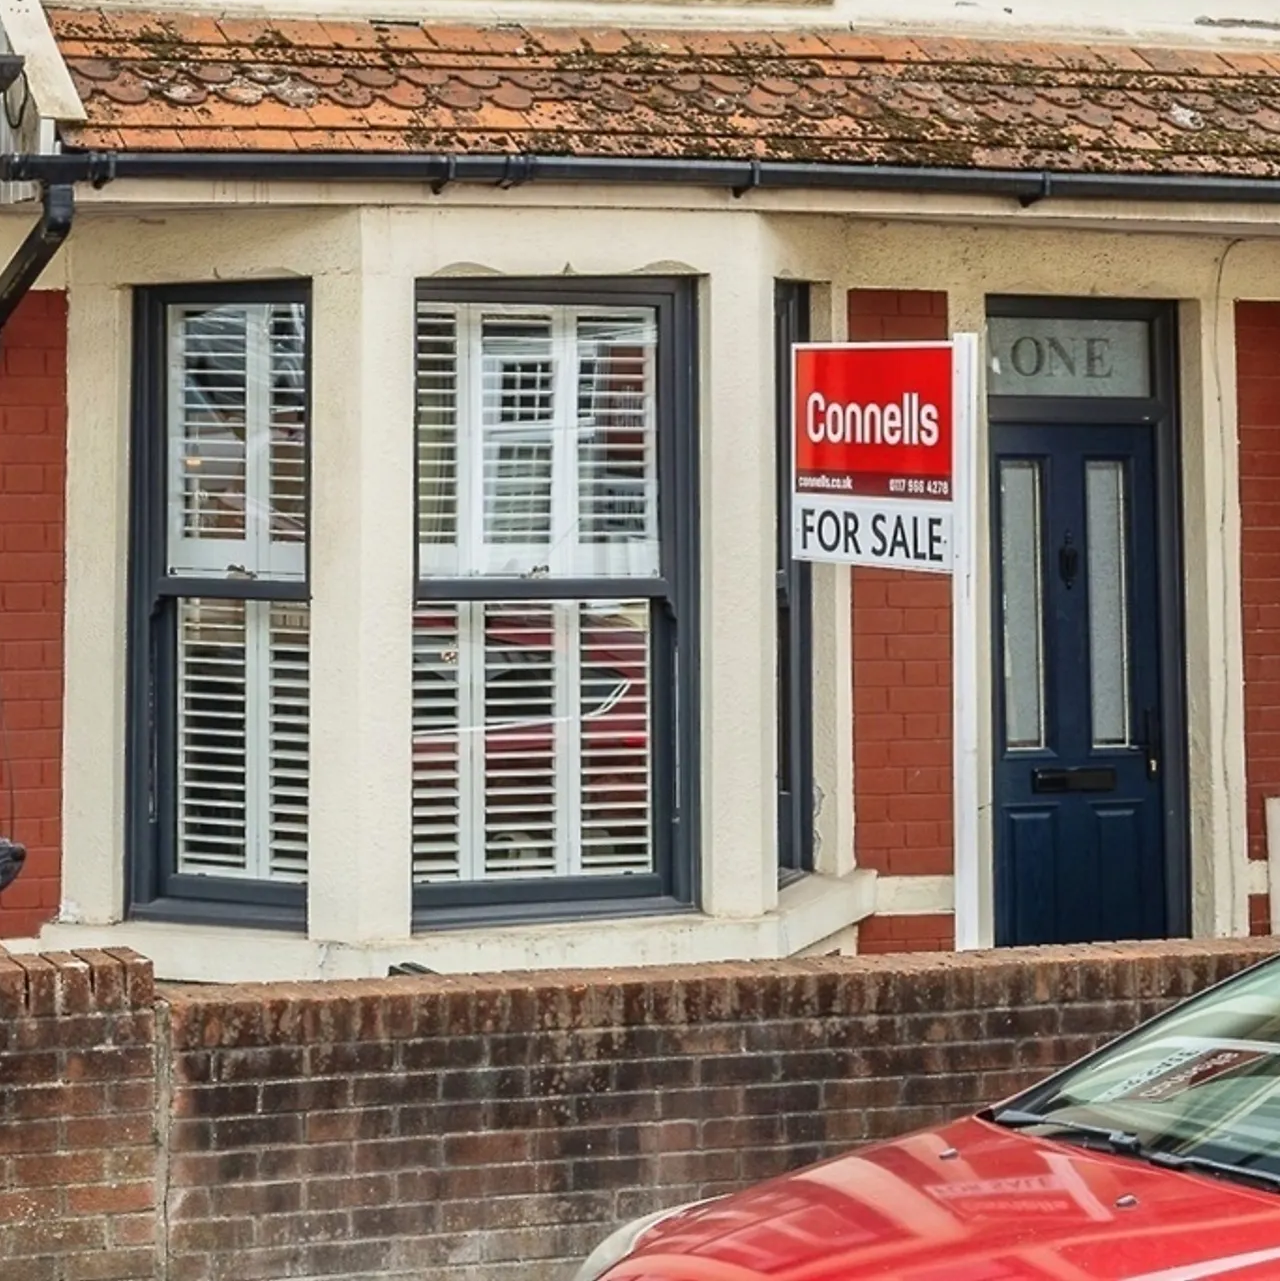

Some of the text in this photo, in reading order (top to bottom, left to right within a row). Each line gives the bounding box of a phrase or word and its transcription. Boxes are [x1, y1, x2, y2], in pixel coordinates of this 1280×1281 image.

[1010, 336, 1113, 378] ONE
[806, 391, 940, 447] Connells
[798, 475, 853, 490] connells.co.uk
[889, 479, 905, 492] 0117
[801, 508, 943, 561] FOR SALE
